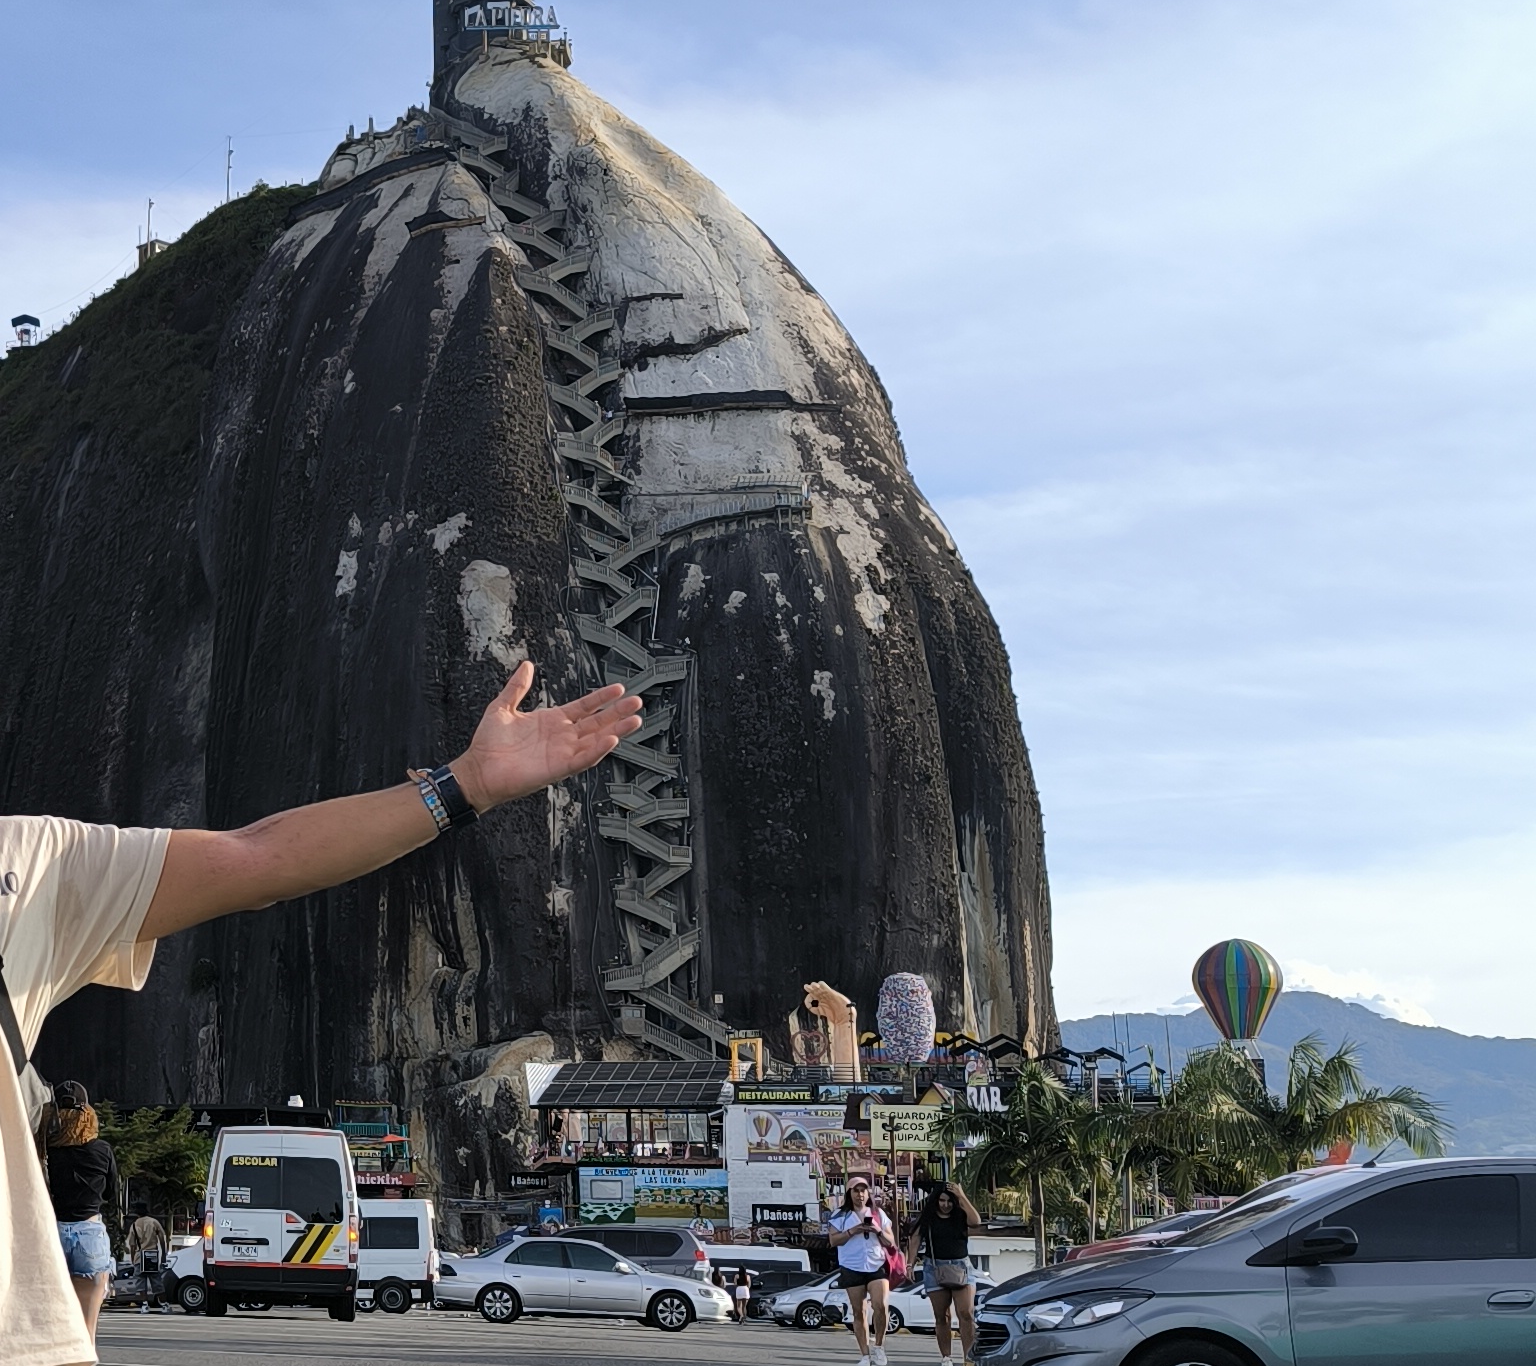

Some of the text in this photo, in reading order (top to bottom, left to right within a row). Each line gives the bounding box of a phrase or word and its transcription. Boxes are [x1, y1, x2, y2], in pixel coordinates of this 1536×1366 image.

[738, 1091, 811, 1100] RESTAURANTE
[872, 1111, 886, 1120] SE
[882, 1133, 933, 1142] EUIPAJE
[232, 1157, 278, 1166] ESCOLAR
[763, 1209, 794, 1221] Baños
